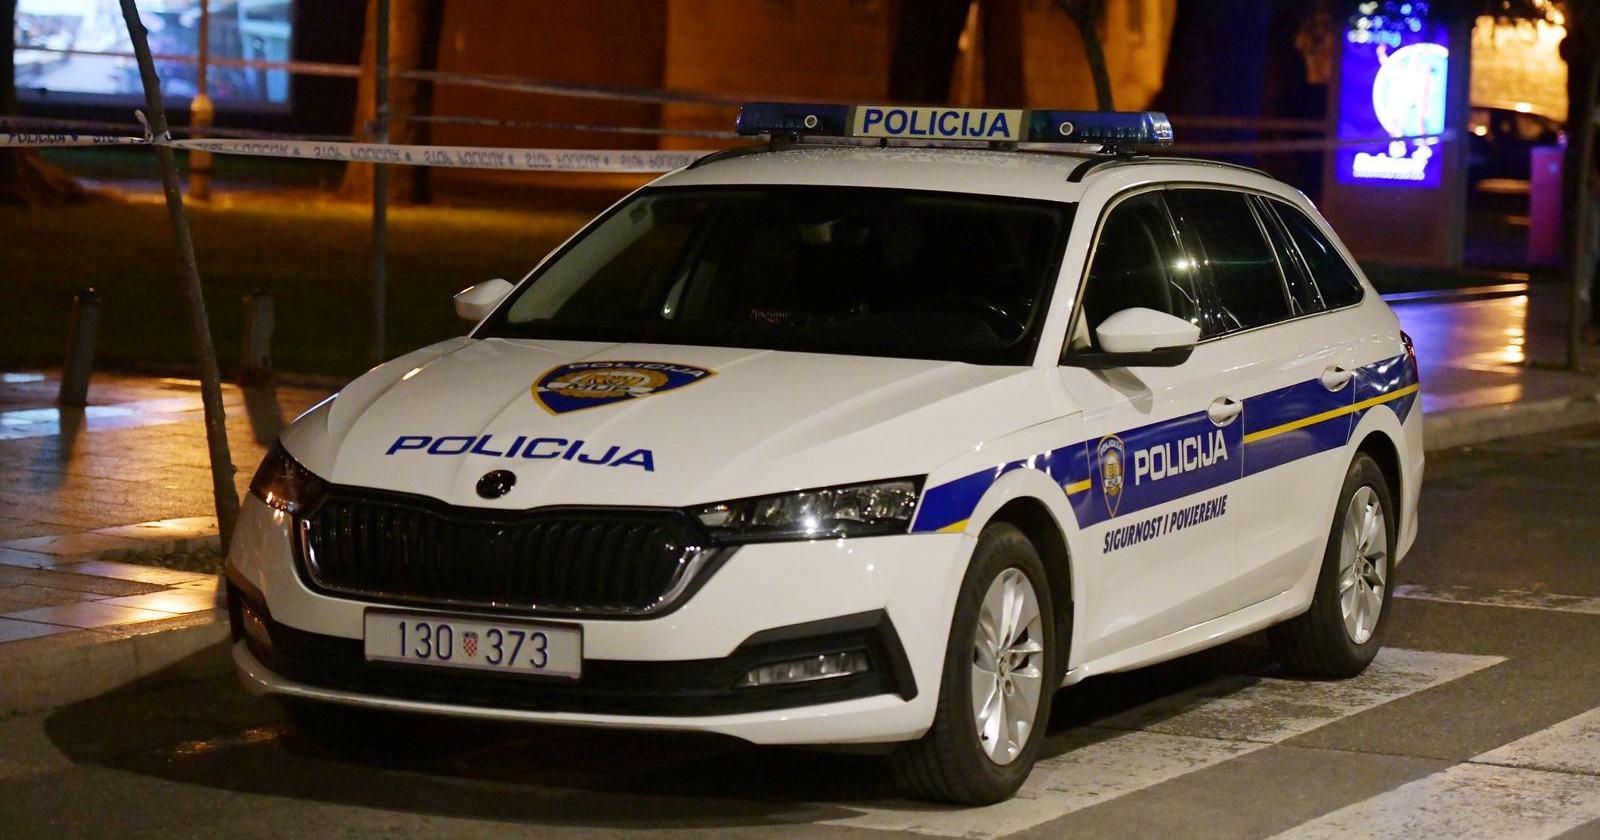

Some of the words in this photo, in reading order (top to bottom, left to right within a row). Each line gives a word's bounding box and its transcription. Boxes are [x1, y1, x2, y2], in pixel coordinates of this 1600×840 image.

[863, 108, 1010, 138] POLICIJA
[568, 362, 706, 378] POLICIJA
[385, 434, 655, 472] POLICIJA
[1134, 429, 1229, 486] POLICIJA
[1103, 514, 1164, 554] SIGURNOST
[1163, 513, 1170, 535] I
[1169, 494, 1228, 533] POVJERENJE
[400, 621, 453, 660] 130
[485, 628, 548, 669] 373
